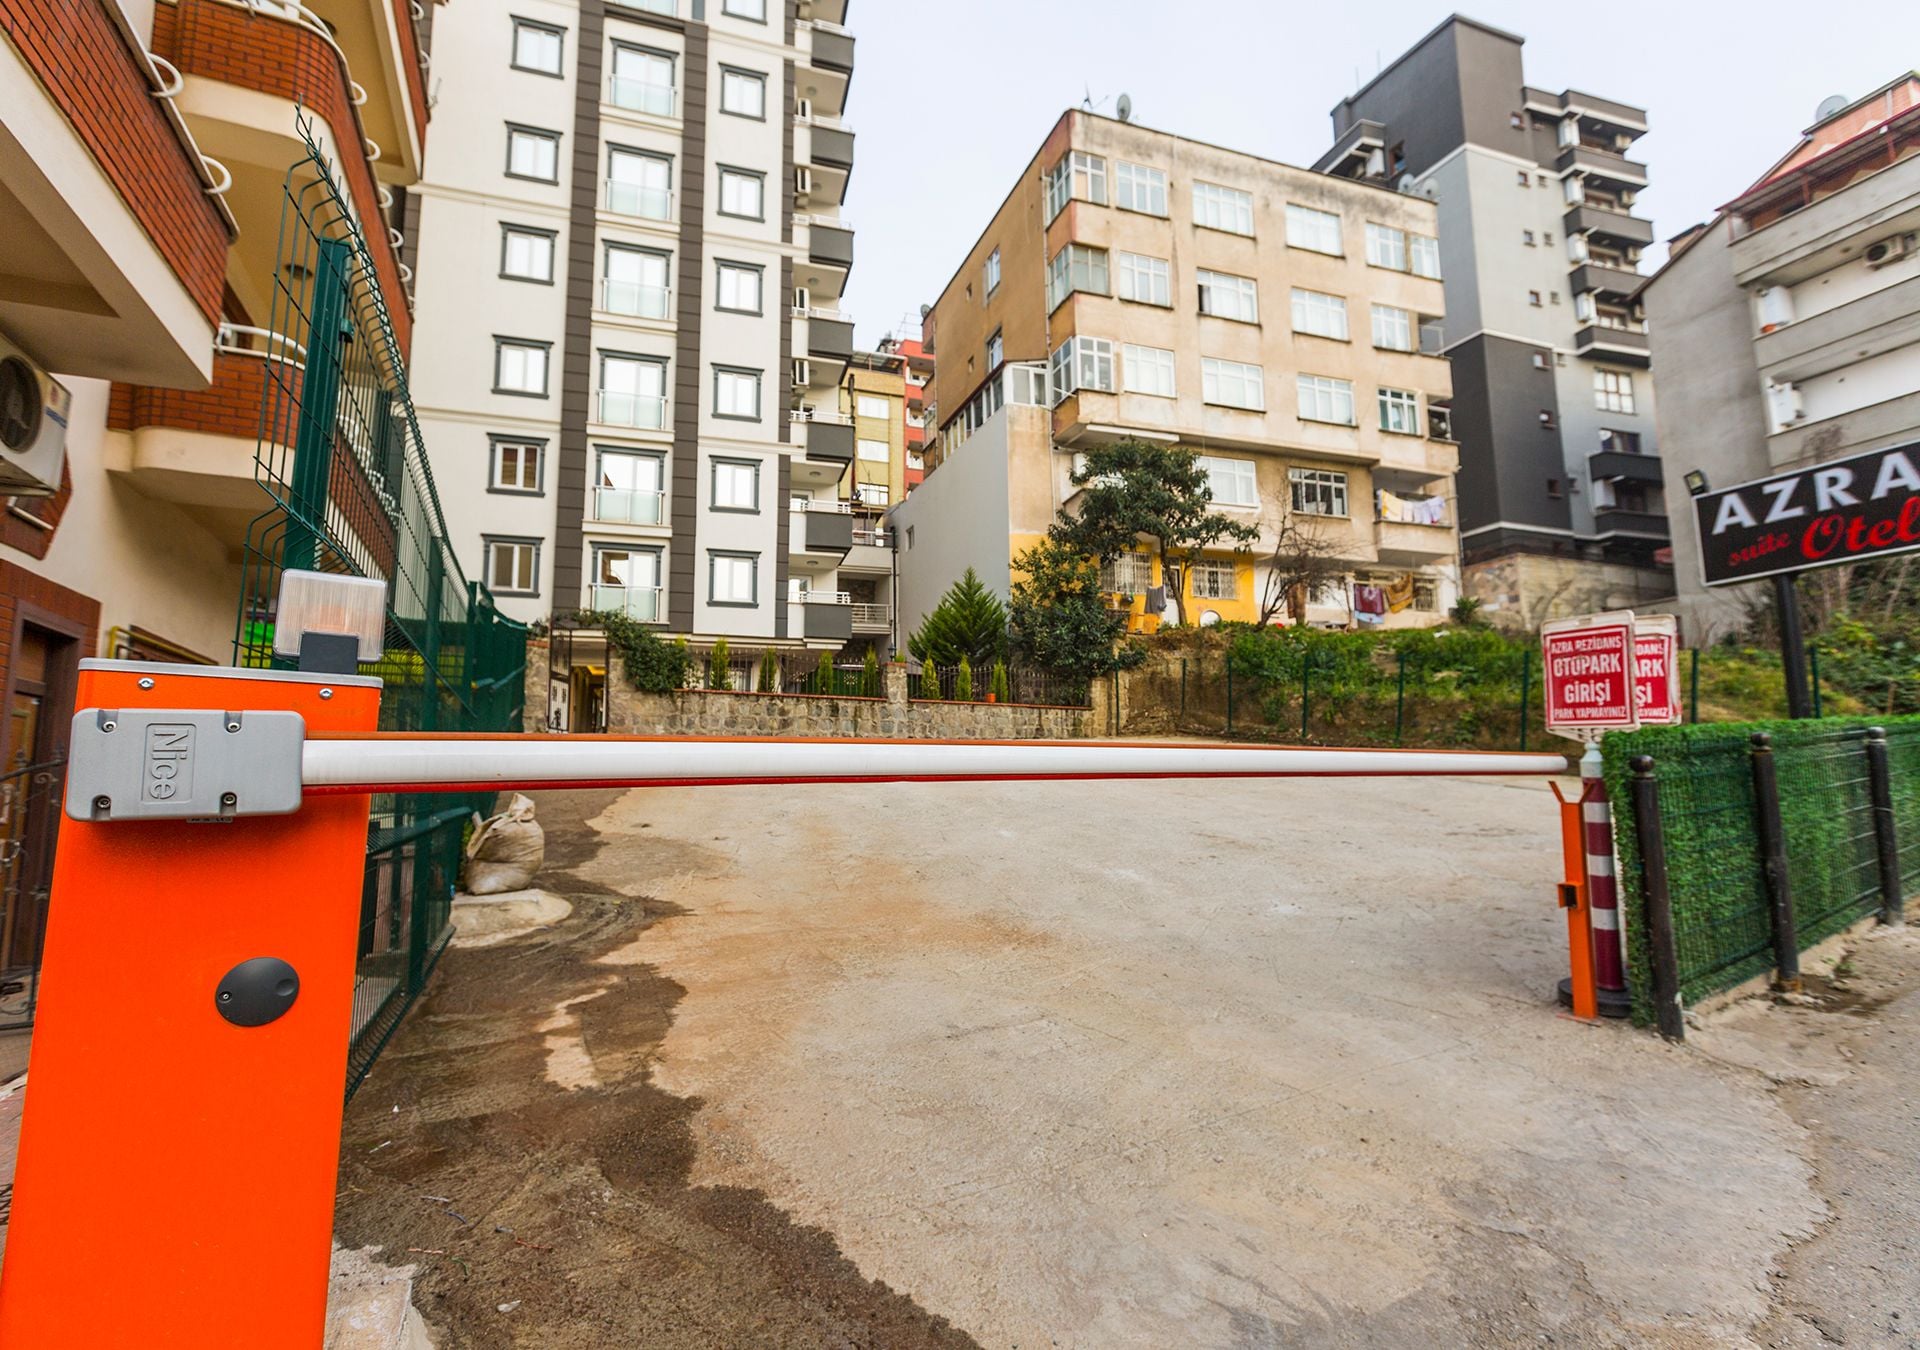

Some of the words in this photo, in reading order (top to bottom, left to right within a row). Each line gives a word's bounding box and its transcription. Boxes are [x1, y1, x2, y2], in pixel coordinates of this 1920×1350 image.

[1711, 451, 1920, 536] AZRA
[1728, 531, 1792, 567] suite
[1800, 495, 1920, 560] Otel
[1551, 641, 1574, 654] AZRA
[1553, 652, 1622, 678] OTOPARK
[1564, 678, 1611, 706] GİRİŞİ
[1553, 708, 1575, 719] PARK
[148, 728, 190, 801] Nice
